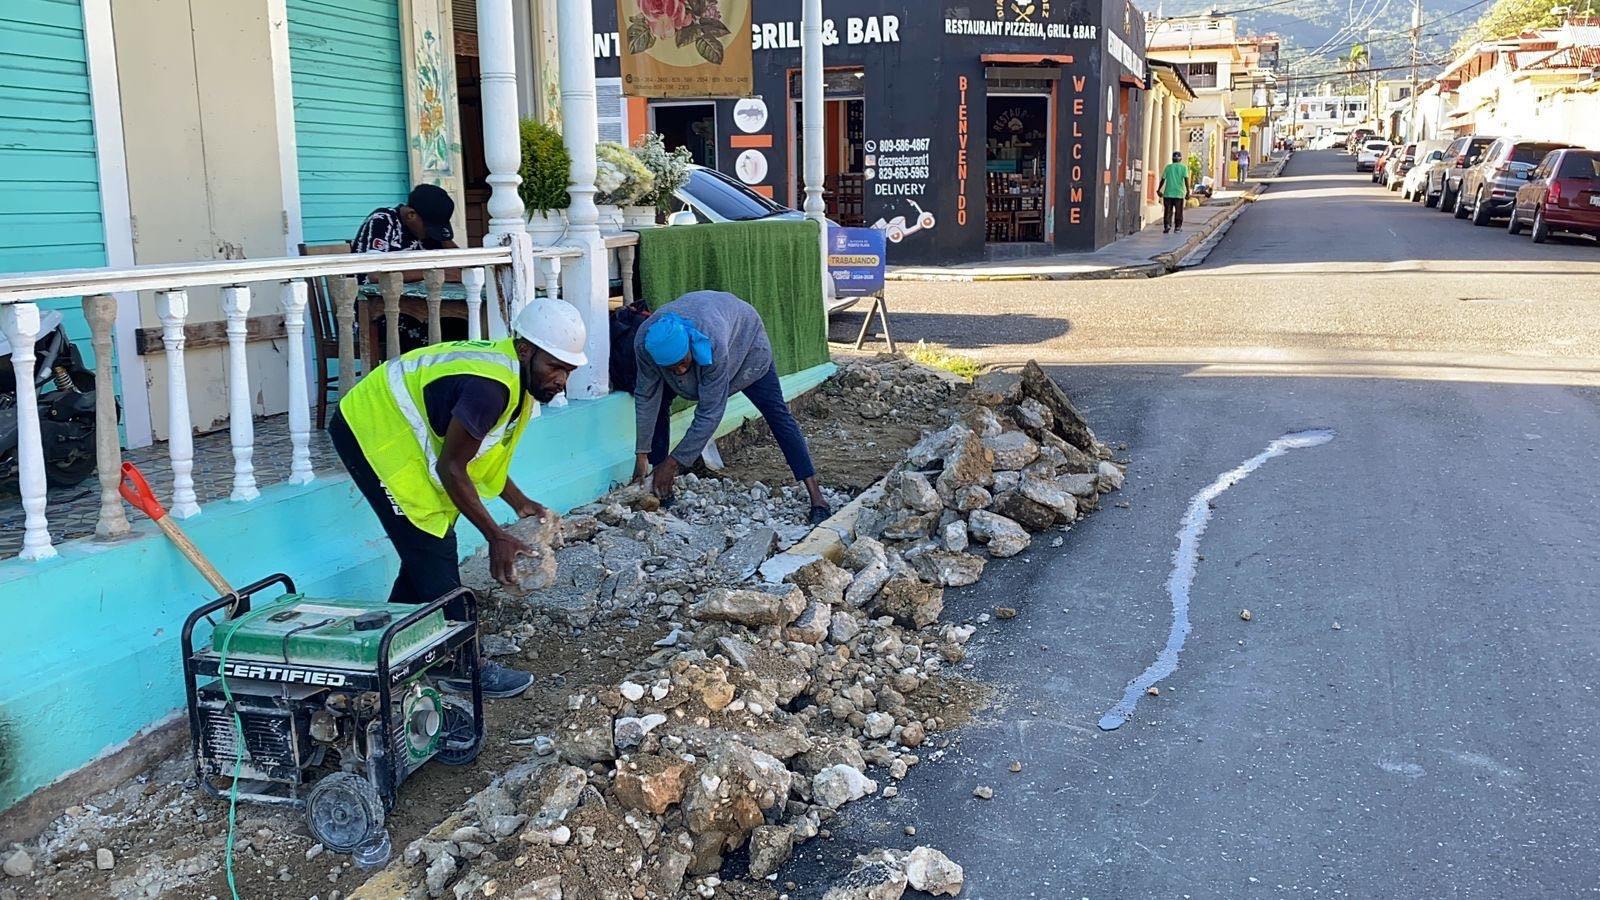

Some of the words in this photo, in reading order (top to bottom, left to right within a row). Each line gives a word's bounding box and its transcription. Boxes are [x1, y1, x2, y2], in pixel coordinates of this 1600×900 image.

[752, 21, 804, 50] GRIL
[822, 19, 839, 46] &
[847, 15, 900, 44] BAR
[945, 19, 1004, 36] RESTAURANT
[1004, 21, 1047, 40] PIZZERIA,
[1047, 23, 1071, 39] GRILL
[879, 138, 930, 152] 809-586-4867
[957, 75, 968, 226] BIENVENIDO
[1070, 75, 1086, 224] WELCOME
[879, 166, 929, 180] 829-663-5963
[875, 183, 926, 195] DELIVERY
[217, 663, 346, 687] CERTIFIED
